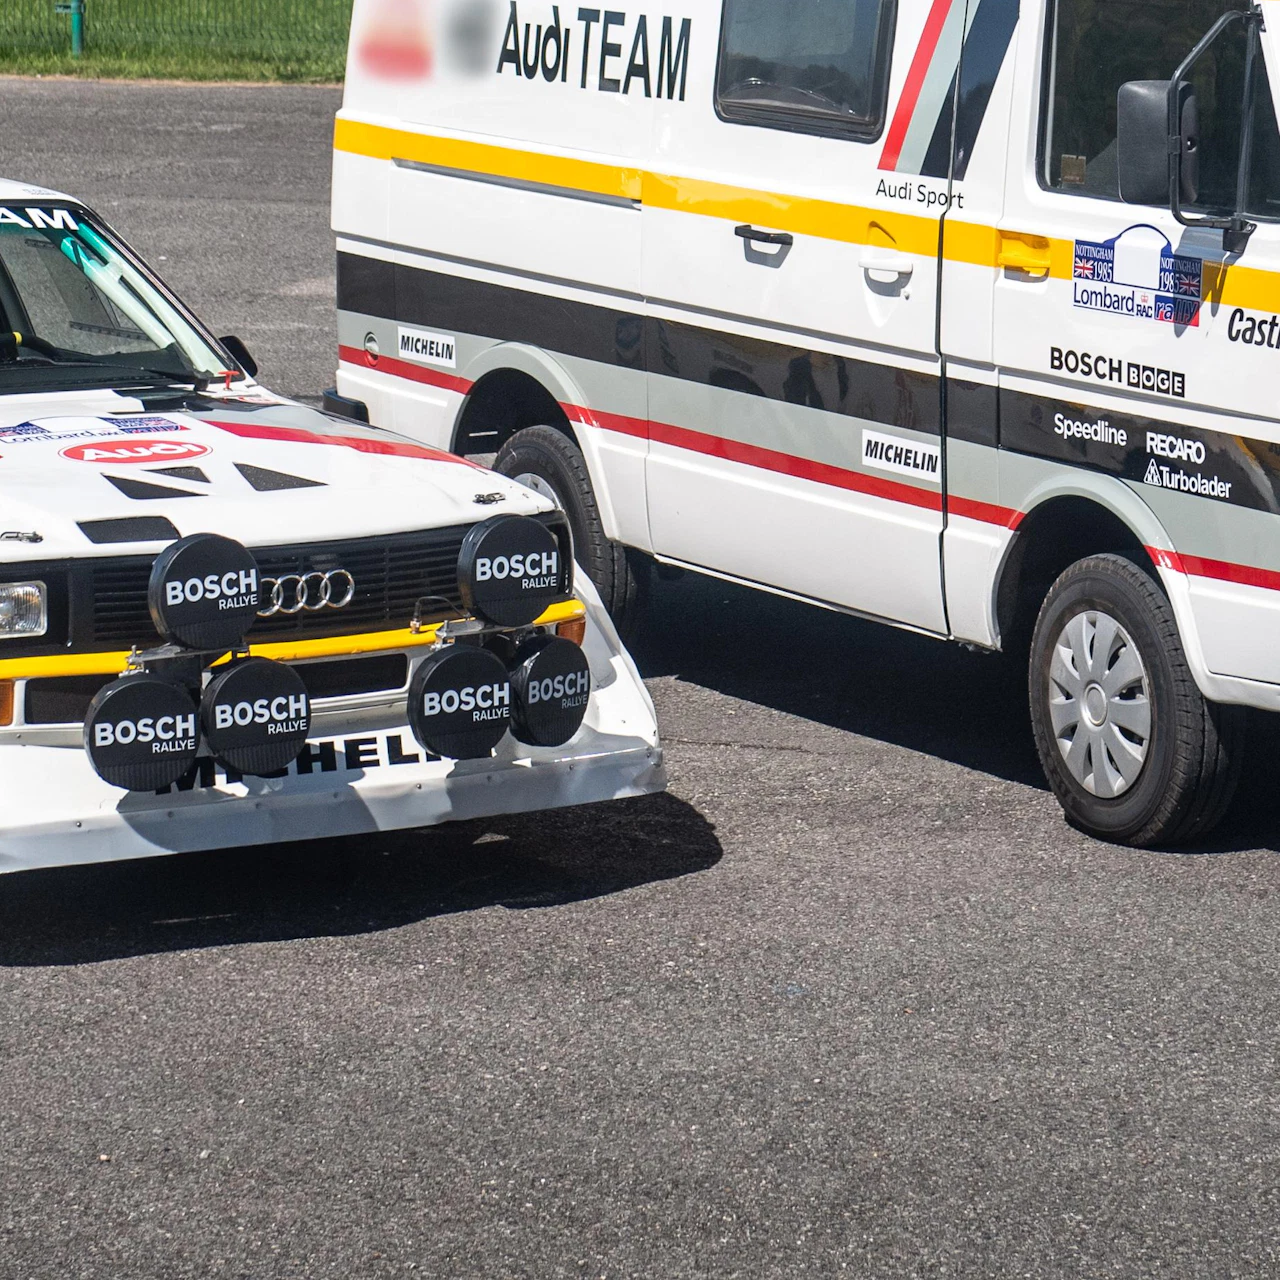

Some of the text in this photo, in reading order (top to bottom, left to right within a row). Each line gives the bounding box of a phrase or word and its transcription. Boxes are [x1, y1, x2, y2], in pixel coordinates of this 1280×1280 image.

[496, 0, 692, 102] Audi TEAM
[875, 178, 964, 209] Audi Sport
[1075, 244, 1113, 262] NOTTINGHAM
[1160, 256, 1201, 273] NOTTINGHAM
[1093, 261, 1113, 282] 1985
[1159, 271, 1180, 293] 1985
[1073, 282, 1199, 326] Lombard RAC rally
[401, 335, 454, 360] MICHELIN
[1050, 346, 1122, 383] BOSCH
[1129, 364, 1184, 396] BOGE
[1054, 413, 1127, 446] Speedline
[82, 443, 200, 461] Audi
[865, 439, 938, 473] MICHELIN
[1146, 432, 1206, 464] RECARO
[1159, 466, 1231, 498] Turbolader
[476, 551, 557, 581] BOSCH
[165, 569, 258, 606] BOSCH
[522, 576, 556, 589] RALLYE
[218, 594, 258, 610] RALLYE
[424, 683, 510, 717] BOSCH
[528, 670, 589, 704] BOSCH
[561, 694, 588, 709] RALLYE
[215, 694, 307, 729] BOSCH
[267, 719, 307, 735] RALLYE
[472, 707, 509, 722] RALLYE
[94, 714, 196, 747] BOSCH
[152, 739, 196, 754] RALLYE
